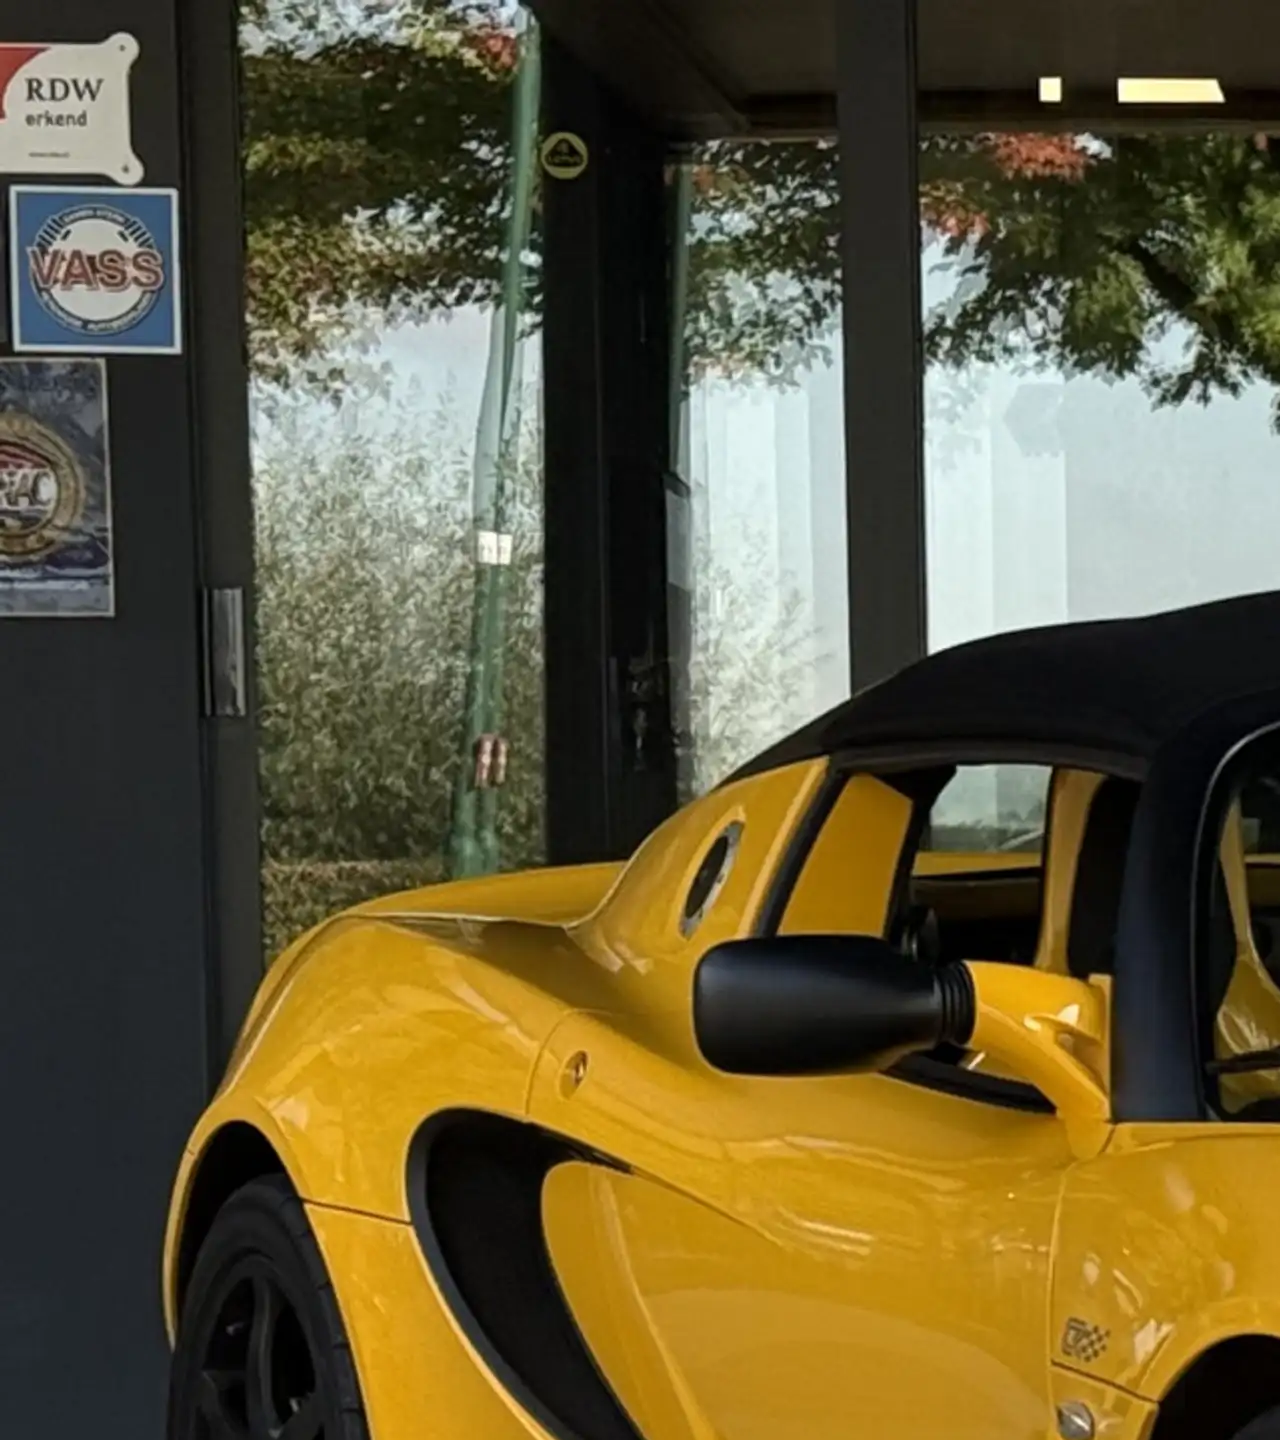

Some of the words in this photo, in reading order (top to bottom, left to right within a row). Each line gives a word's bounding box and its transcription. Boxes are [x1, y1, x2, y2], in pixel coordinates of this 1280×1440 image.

[25, 77, 105, 102] RDW
[25, 109, 88, 127] erkend
[26, 247, 165, 292] VASS
